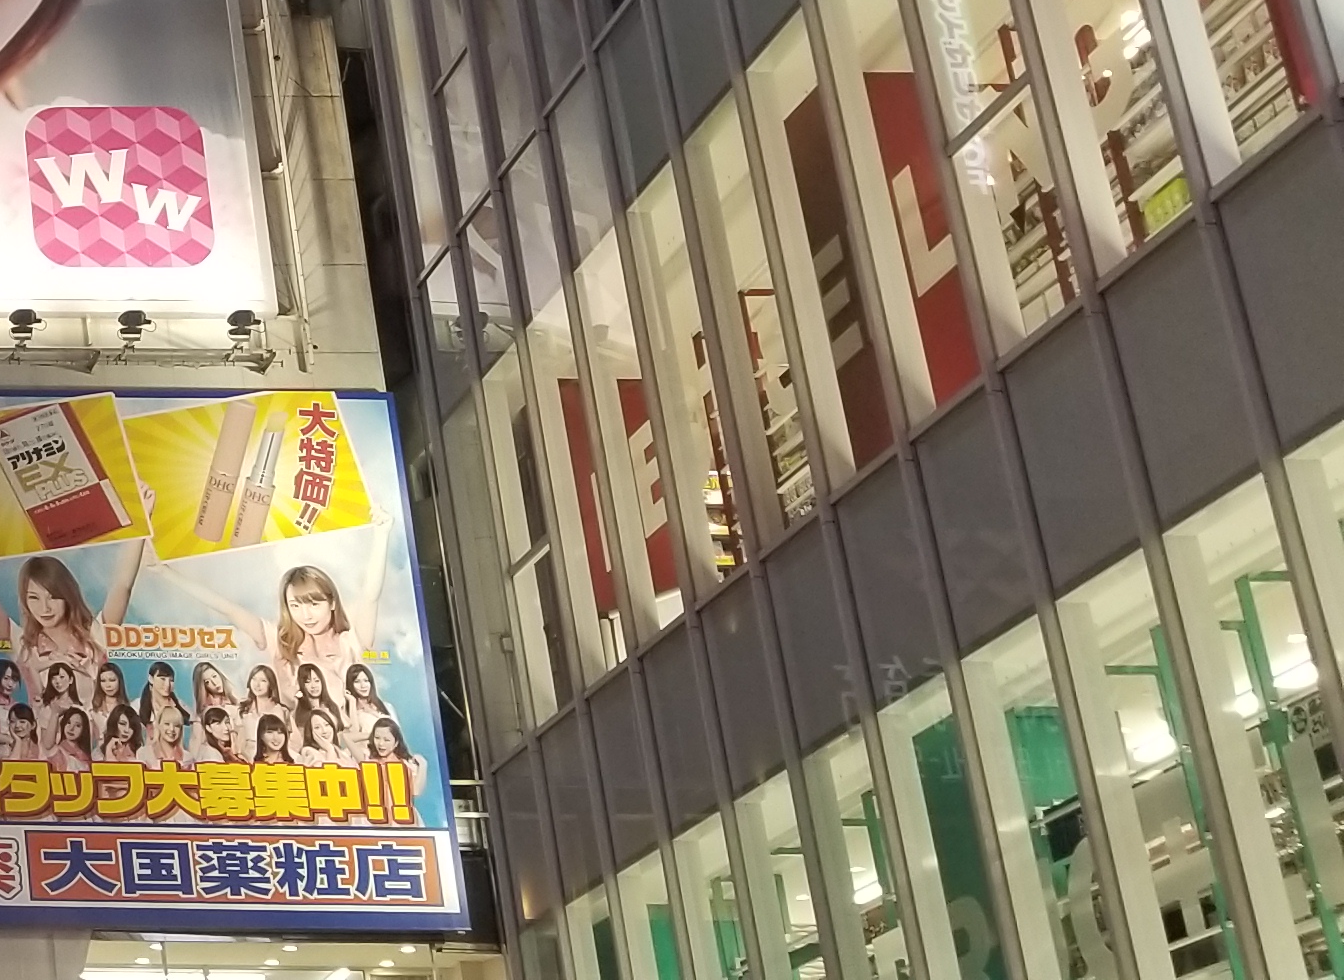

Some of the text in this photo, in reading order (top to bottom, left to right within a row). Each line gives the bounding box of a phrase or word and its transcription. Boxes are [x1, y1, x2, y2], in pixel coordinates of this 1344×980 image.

[6, 437, 67, 471] アリナミン
[292, 401, 339, 532] 大特価!!
[14, 451, 76, 493] EX
[34, 468, 90, 502] PLUS
[209, 475, 235, 492] DHC
[244, 487, 271, 504] DHC
[104, 625, 238, 649] DDプリンセス
[42, 837, 429, 902] 大国薬粧店
